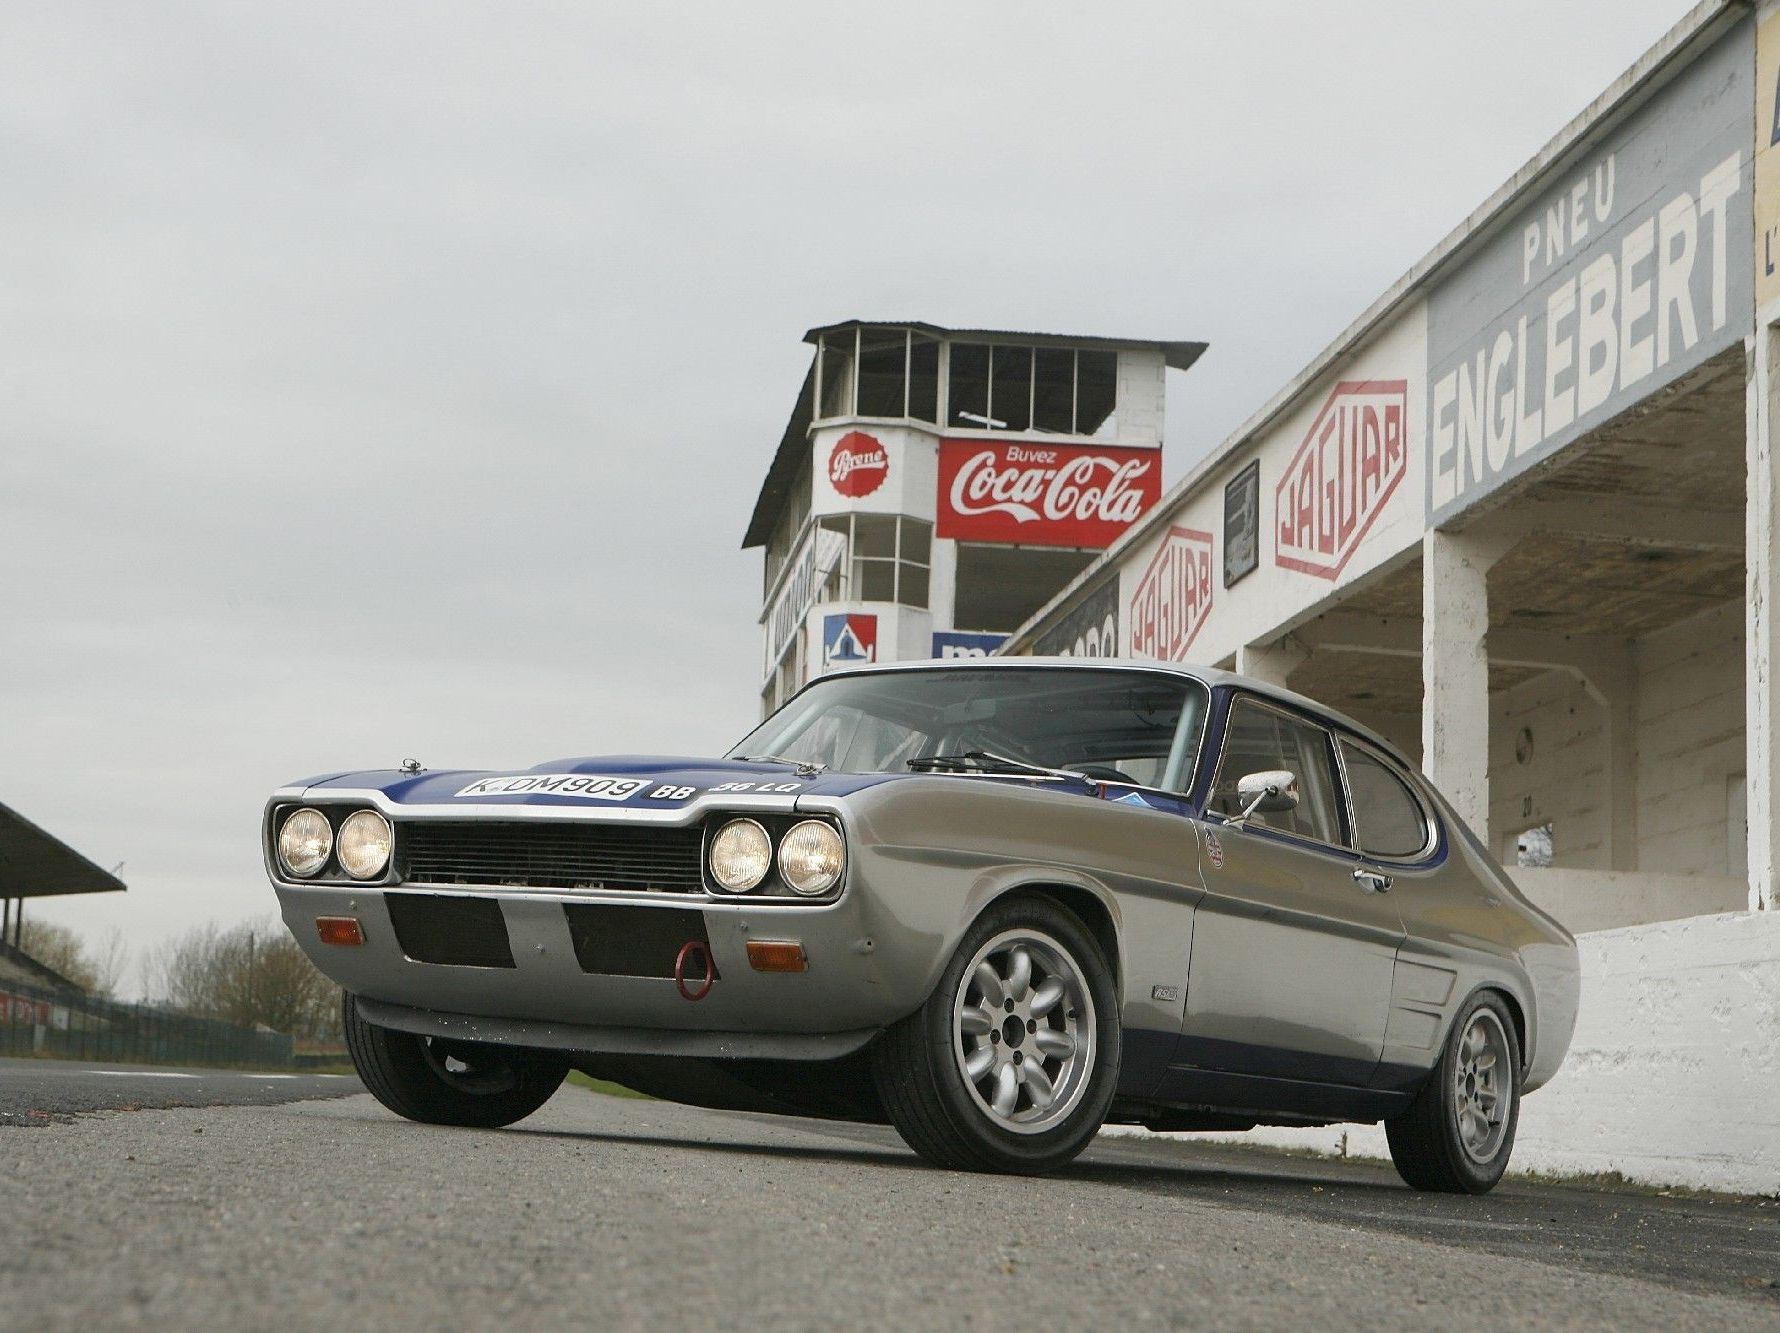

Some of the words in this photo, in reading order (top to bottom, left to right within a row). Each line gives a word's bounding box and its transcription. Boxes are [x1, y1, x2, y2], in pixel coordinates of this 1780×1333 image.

[1523, 153, 1616, 286] PNEU
[1432, 149, 1742, 514] ENGLEBERT
[950, 450, 1151, 524] Coca-Cola
[1006, 445, 1057, 465] Buvez
[1280, 404, 1401, 556] JAGUAR
[1133, 543, 1210, 662] JAGUAR
[649, 784, 697, 800] BB
